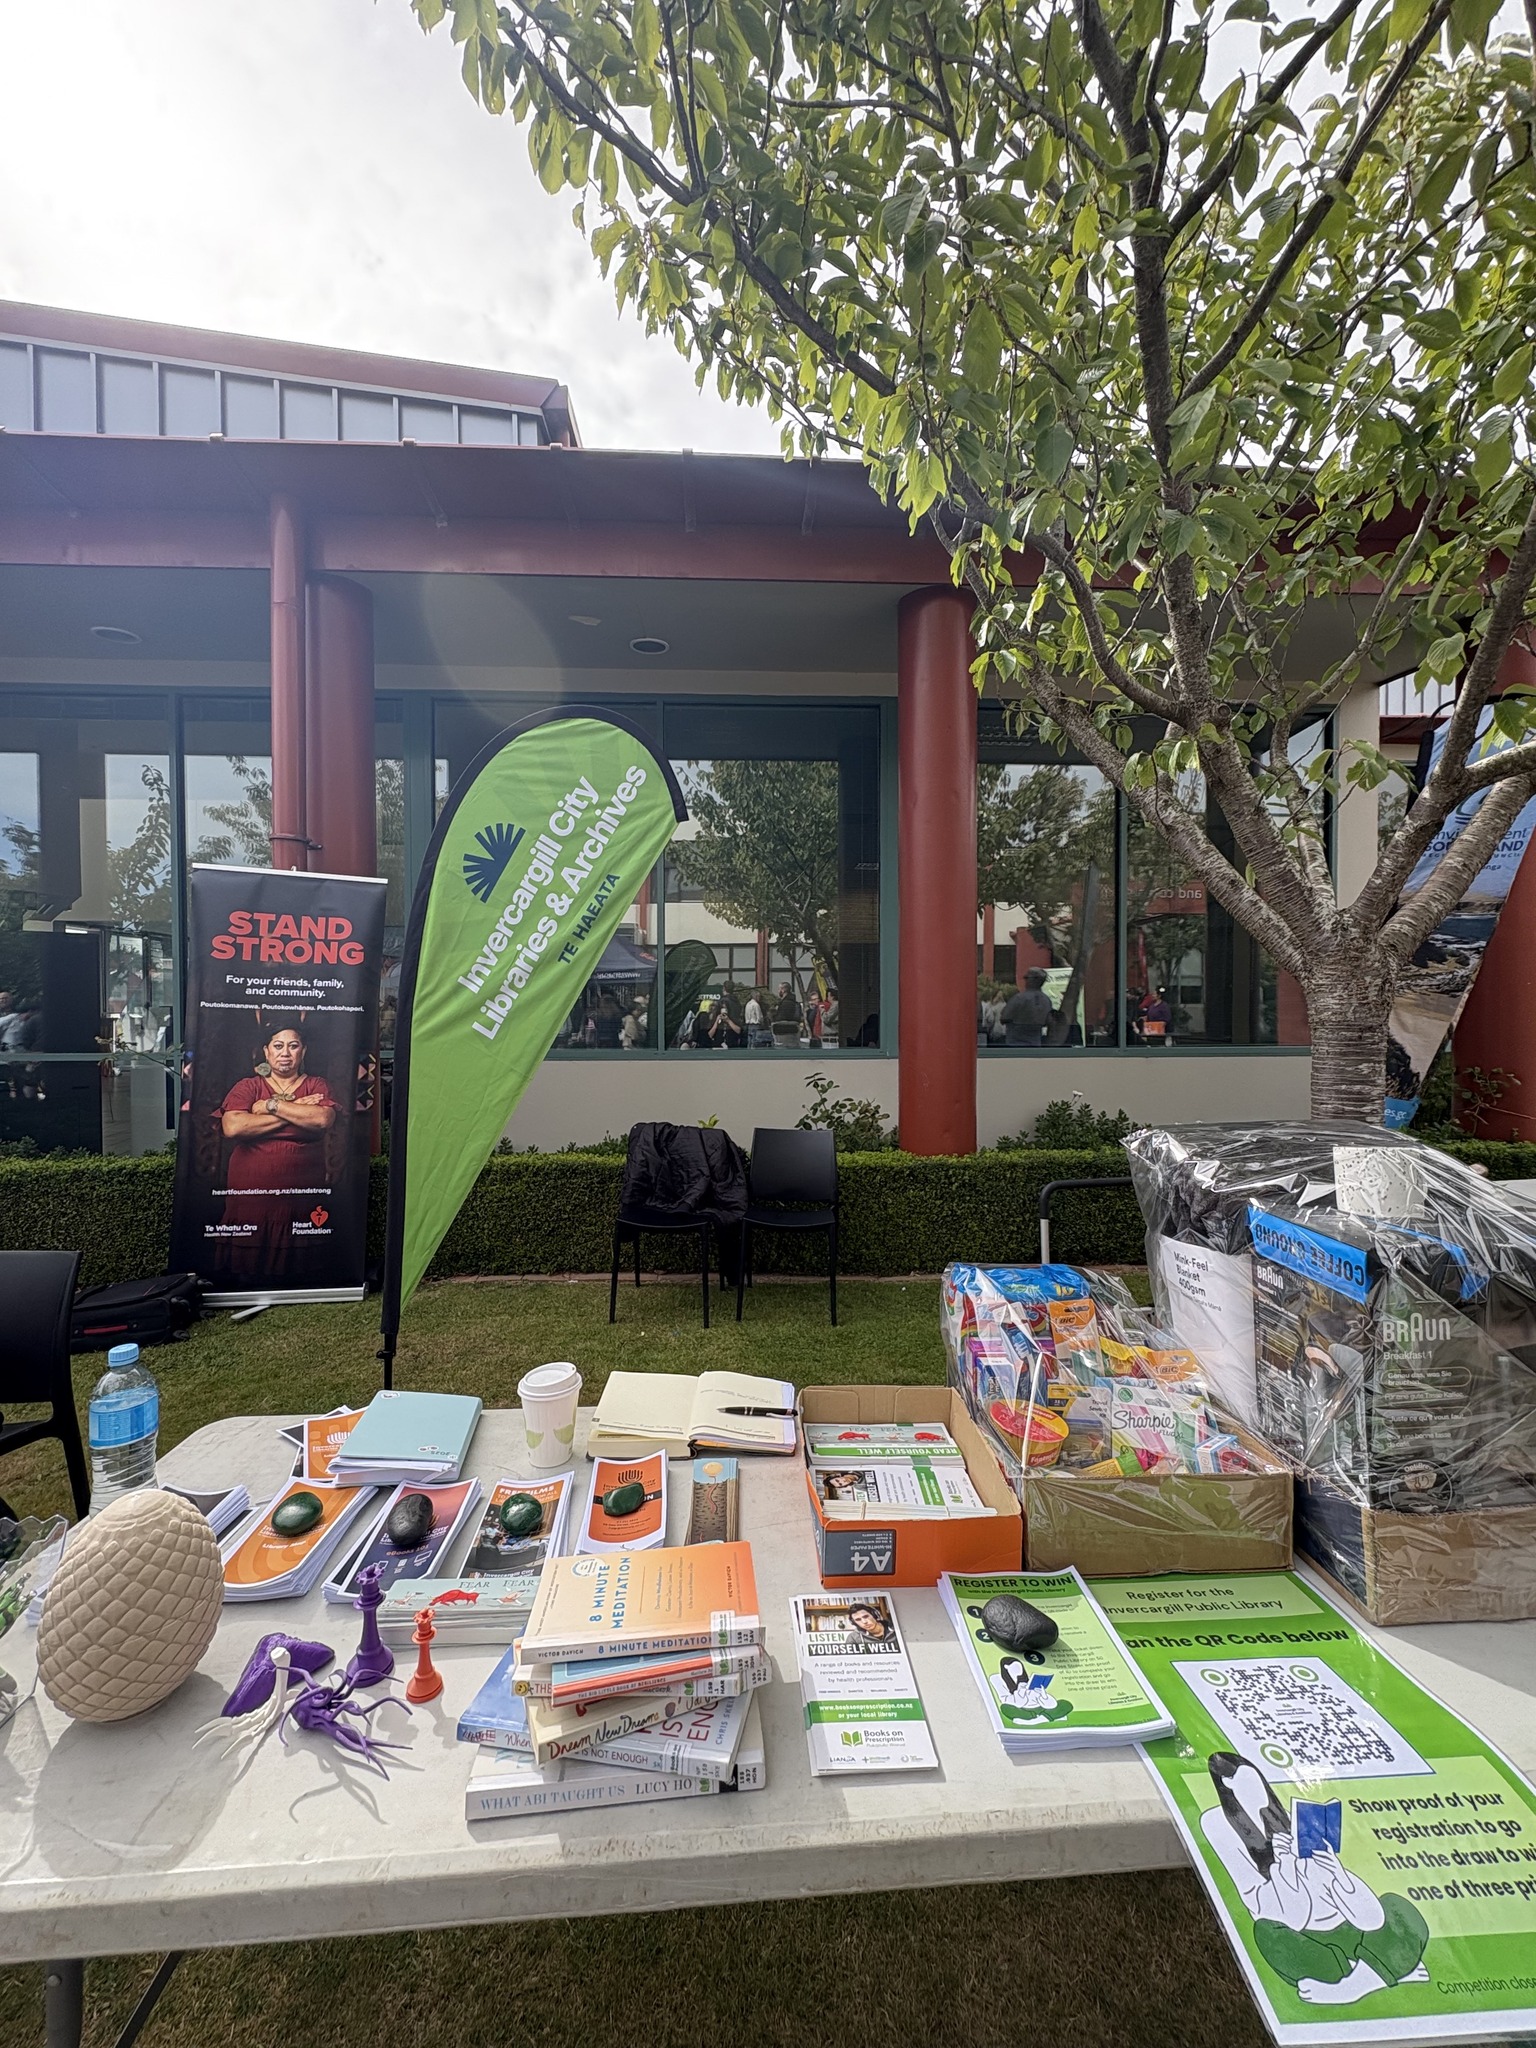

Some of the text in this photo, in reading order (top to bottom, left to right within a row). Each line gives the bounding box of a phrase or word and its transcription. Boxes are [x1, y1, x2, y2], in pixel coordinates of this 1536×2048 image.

[1430, 828, 1527, 841] nvient
[1425, 840, 1524, 852] SOAND
[457, 776, 600, 994] Invercargill City
[471, 916, 558, 1040] Libraries
[545, 892, 574, 917] &
[560, 765, 648, 895] Archives
[228, 910, 353, 940] STAND
[557, 944, 580, 965] TE
[572, 873, 621, 942] HAEATA
[210, 935, 365, 966] STRONG
[225, 975, 345, 990] For your friends, family,
[245, 987, 326, 999] and community.
[1256, 1265, 1284, 1290] BRAUN
[1383, 1312, 1452, 1343] BRAUN
[1383, 1350, 1426, 1360] Breakfast
[1111, 1410, 1176, 1432] Sharpie
[850, 1551, 892, 1572] A4
[954, 1574, 1077, 1588] REGISTER TO WIN!
[589, 1565, 611, 1622] 8 MINUTE
[611, 1557, 631, 1629] MEDITATION
[1125, 1586, 1235, 1602] Register for the
[972, 1608, 979, 1616] 1
[1103, 1597, 1284, 1616] Invercargill Public Library
[809, 1633, 845, 1643] LISTEN
[981, 1631, 990, 1640] 2
[1124, 1628, 1350, 1649] an the QR Code below
[598, 1645, 605, 1654] 8
[609, 1641, 648, 1653] MINUTE
[809, 1642, 899, 1655] YOURSELF WELL
[1030, 1654, 1039, 1662] 3
[535, 1683, 552, 1694] THE
[659, 1719, 684, 1738] IS
[687, 1700, 719, 1742] ENO
[504, 1733, 532, 1748] When
[547, 1734, 593, 1760] Dream
[594, 1720, 621, 1745] New
[715, 1720, 729, 1745] CHRIS
[863, 1729, 890, 1737] Books
[865, 1736, 905, 1744] Prescription
[581, 1748, 649, 1765] IS NOT ENOUGH
[481, 1779, 692, 1811] WHAT ABI TAUGHT US LUCY HO
[1348, 1792, 1506, 1815] Show proof of your
[1372, 1818, 1523, 1845] registration to go
[1377, 1842, 1536, 1870] into the draw to wi
[1407, 1873, 1536, 1901] one of three pri
[1436, 1976, 1511, 1997] Competition
